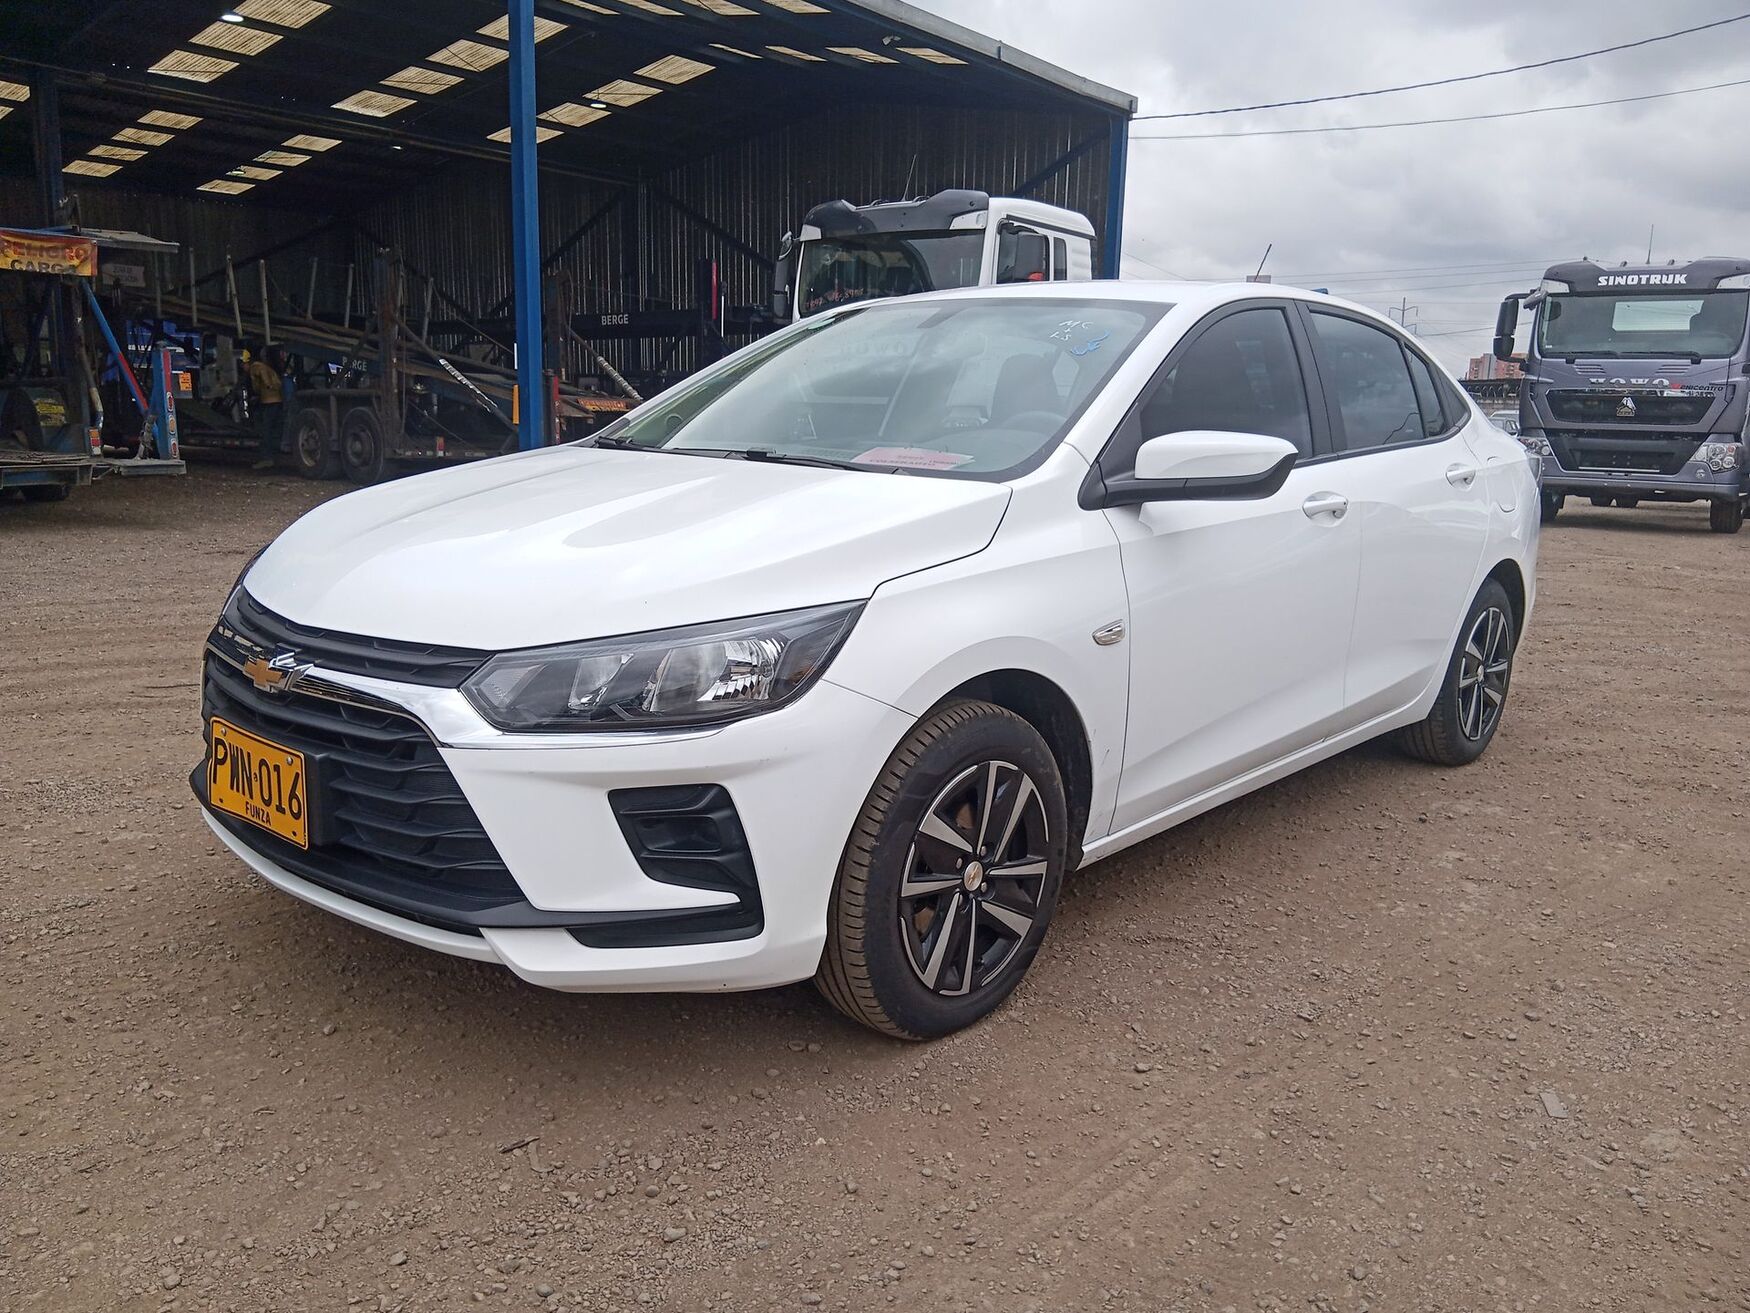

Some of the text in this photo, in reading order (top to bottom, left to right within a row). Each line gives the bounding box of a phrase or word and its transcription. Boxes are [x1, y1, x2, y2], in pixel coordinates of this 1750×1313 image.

[1598, 274, 1687, 285] SINOTRUK
[601, 314, 629, 325] BERGE
[245, 801, 271, 826] FUNZA
